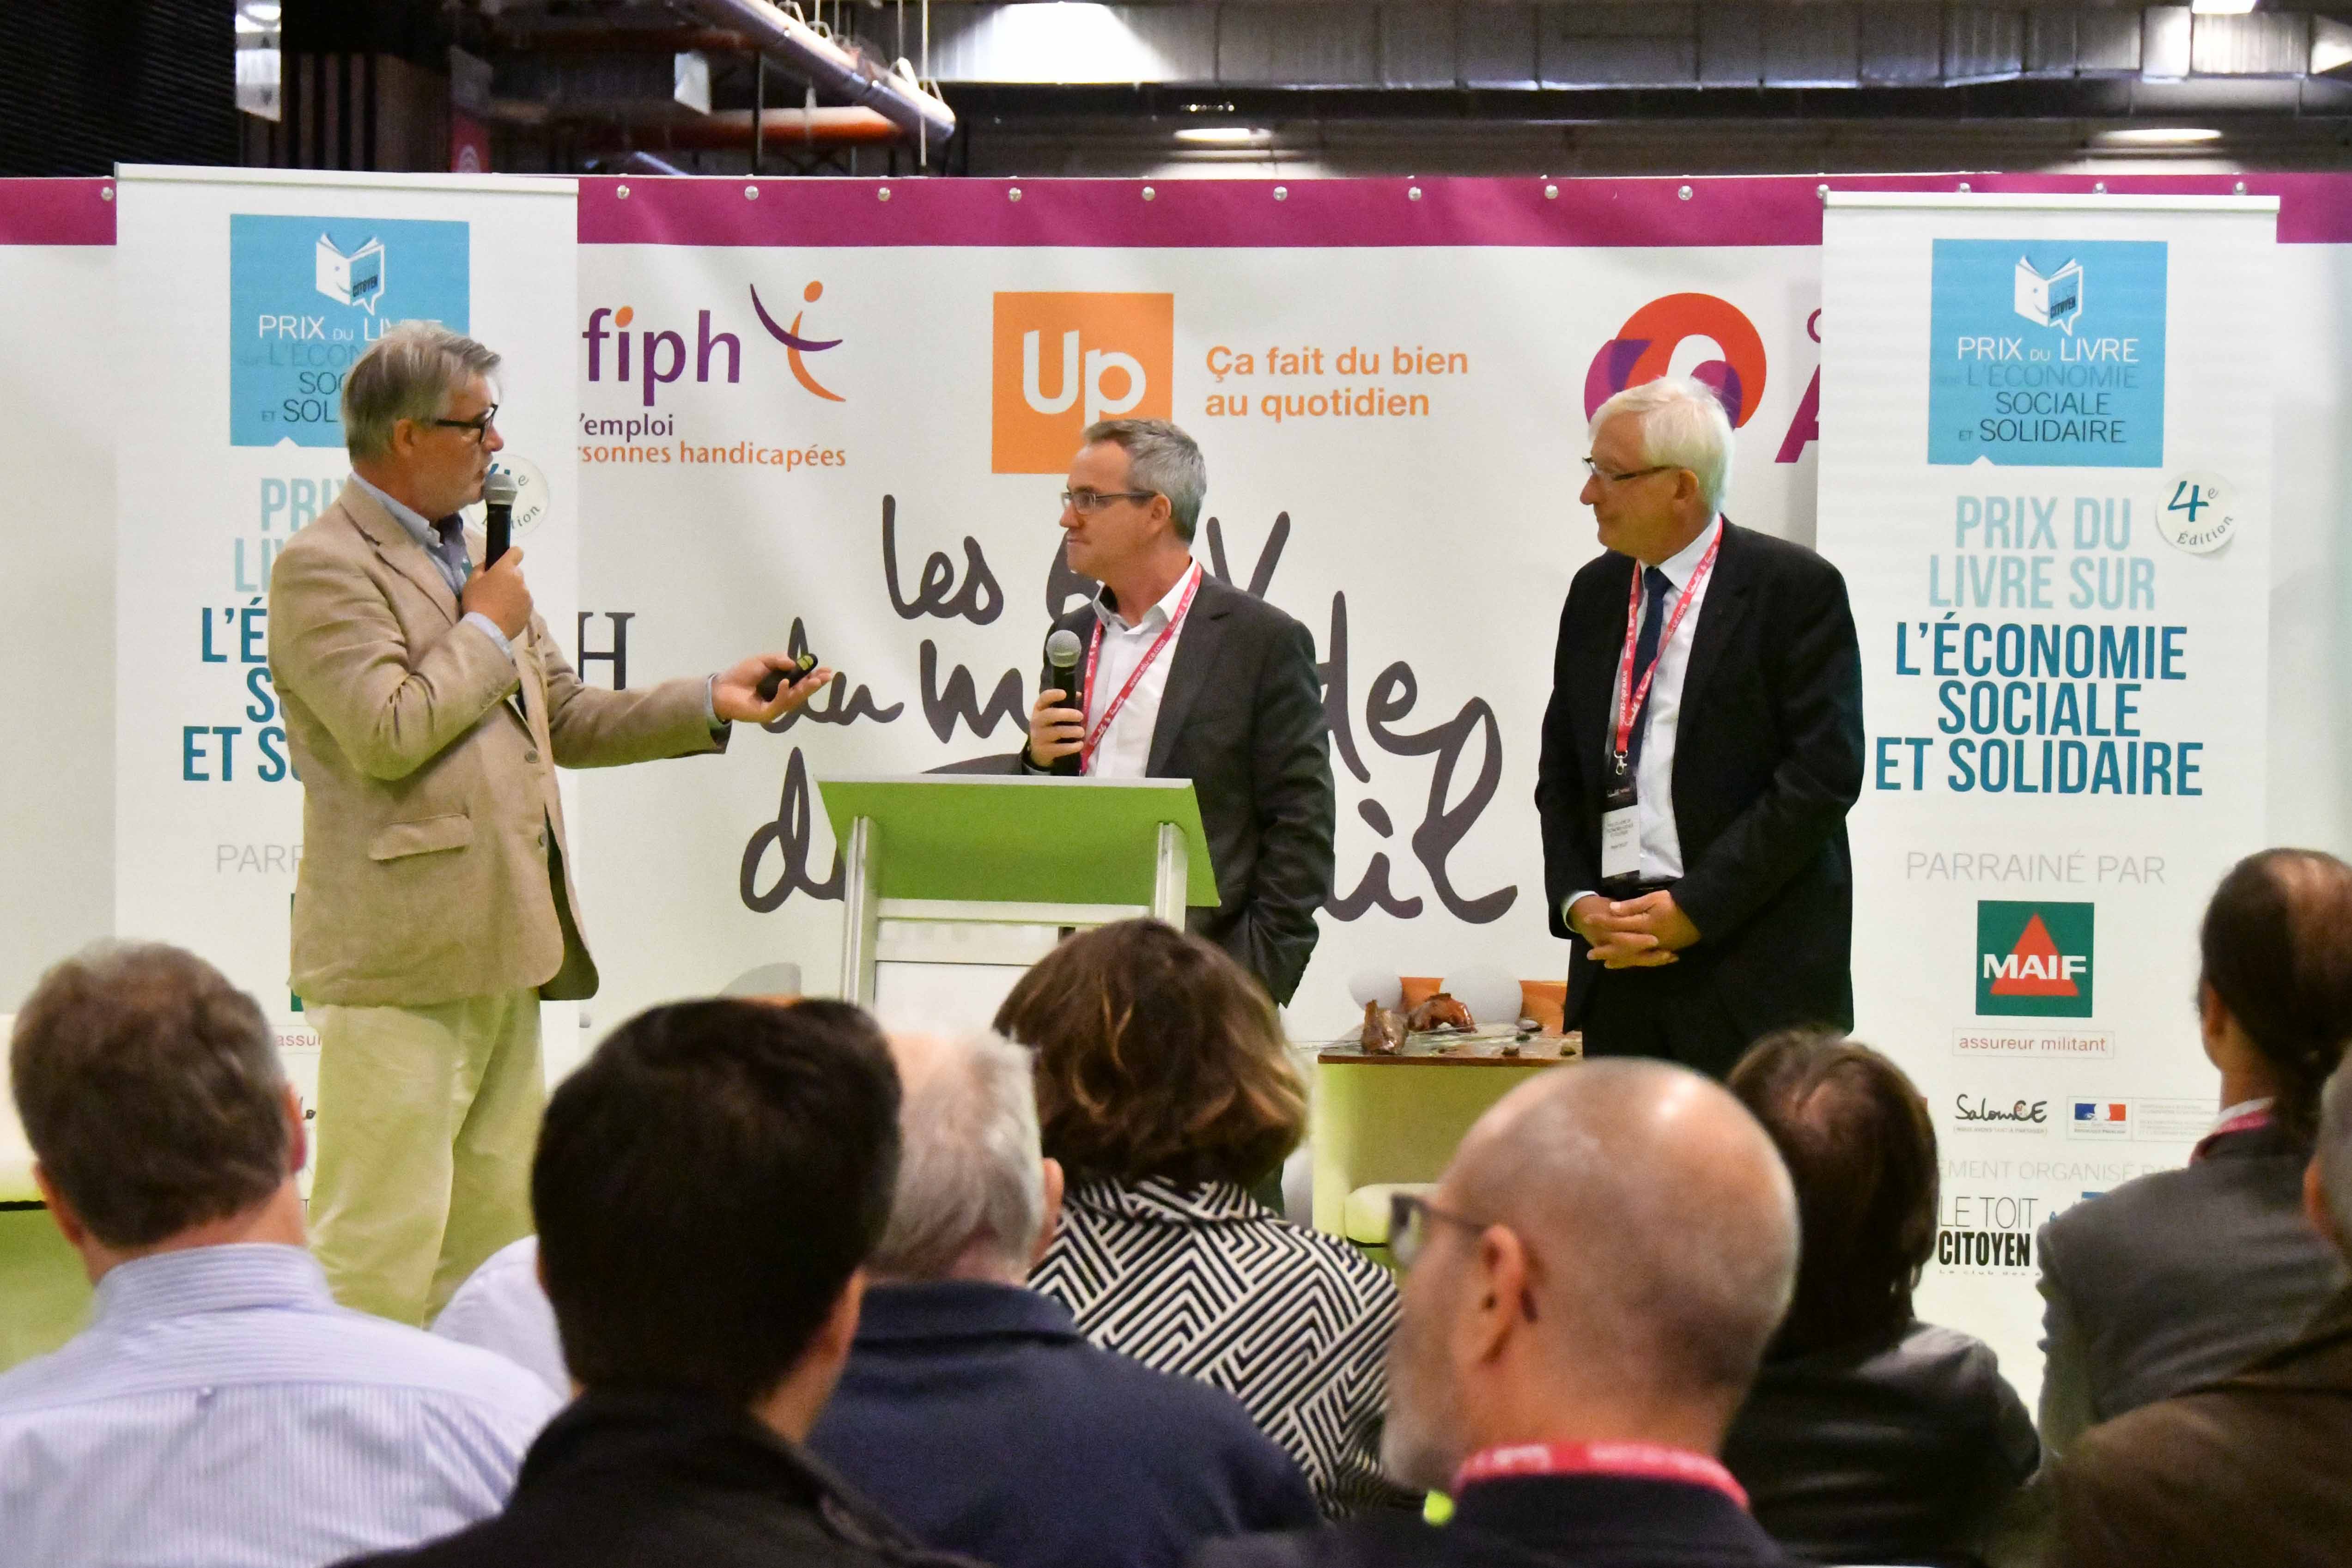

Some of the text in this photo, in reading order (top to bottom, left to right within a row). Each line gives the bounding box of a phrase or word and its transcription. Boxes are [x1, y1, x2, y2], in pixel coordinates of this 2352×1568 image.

[259, 315, 326, 340] PRIX
[333, 328, 354, 341] DU
[582, 306, 740, 407] fiph
[1205, 346, 1468, 383] Ça fait du bien
[1957, 336, 2140, 363] PRIX DU LIVRE
[1023, 330, 1147, 425] Up
[262, 411, 275, 421] ET
[1205, 389, 1429, 423] au quotidien
[1995, 392, 2111, 416] SOCIALE
[579, 413, 674, 443] 'emploi
[1958, 418, 2127, 444] ET SOLIDAIRE
[578, 440, 846, 472] sonnes handicapées
[261, 478, 345, 532] PRI
[1955, 495, 2131, 551] PRIX DU
[2177, 514, 2234, 547] Édition
[882, 494, 1004, 626] les
[1928, 554, 2156, 611] LIVRE SUR
[1896, 611, 2188, 680] L'ÉCONOMIE
[1938, 680, 2142, 737] SOCIALE
[183, 726, 242, 782] ET
[1876, 737, 2203, 796] ET SOLIDAIRE
[1906, 850, 2166, 884] PARRAINÉ PAR
[1983, 954, 2087, 980] MAIF
[1958, 1034, 2106, 1052] assureur militant
[1940, 1195, 2038, 1228] LE TOIT
[1939, 1230, 2030, 1267] CITOYEN
